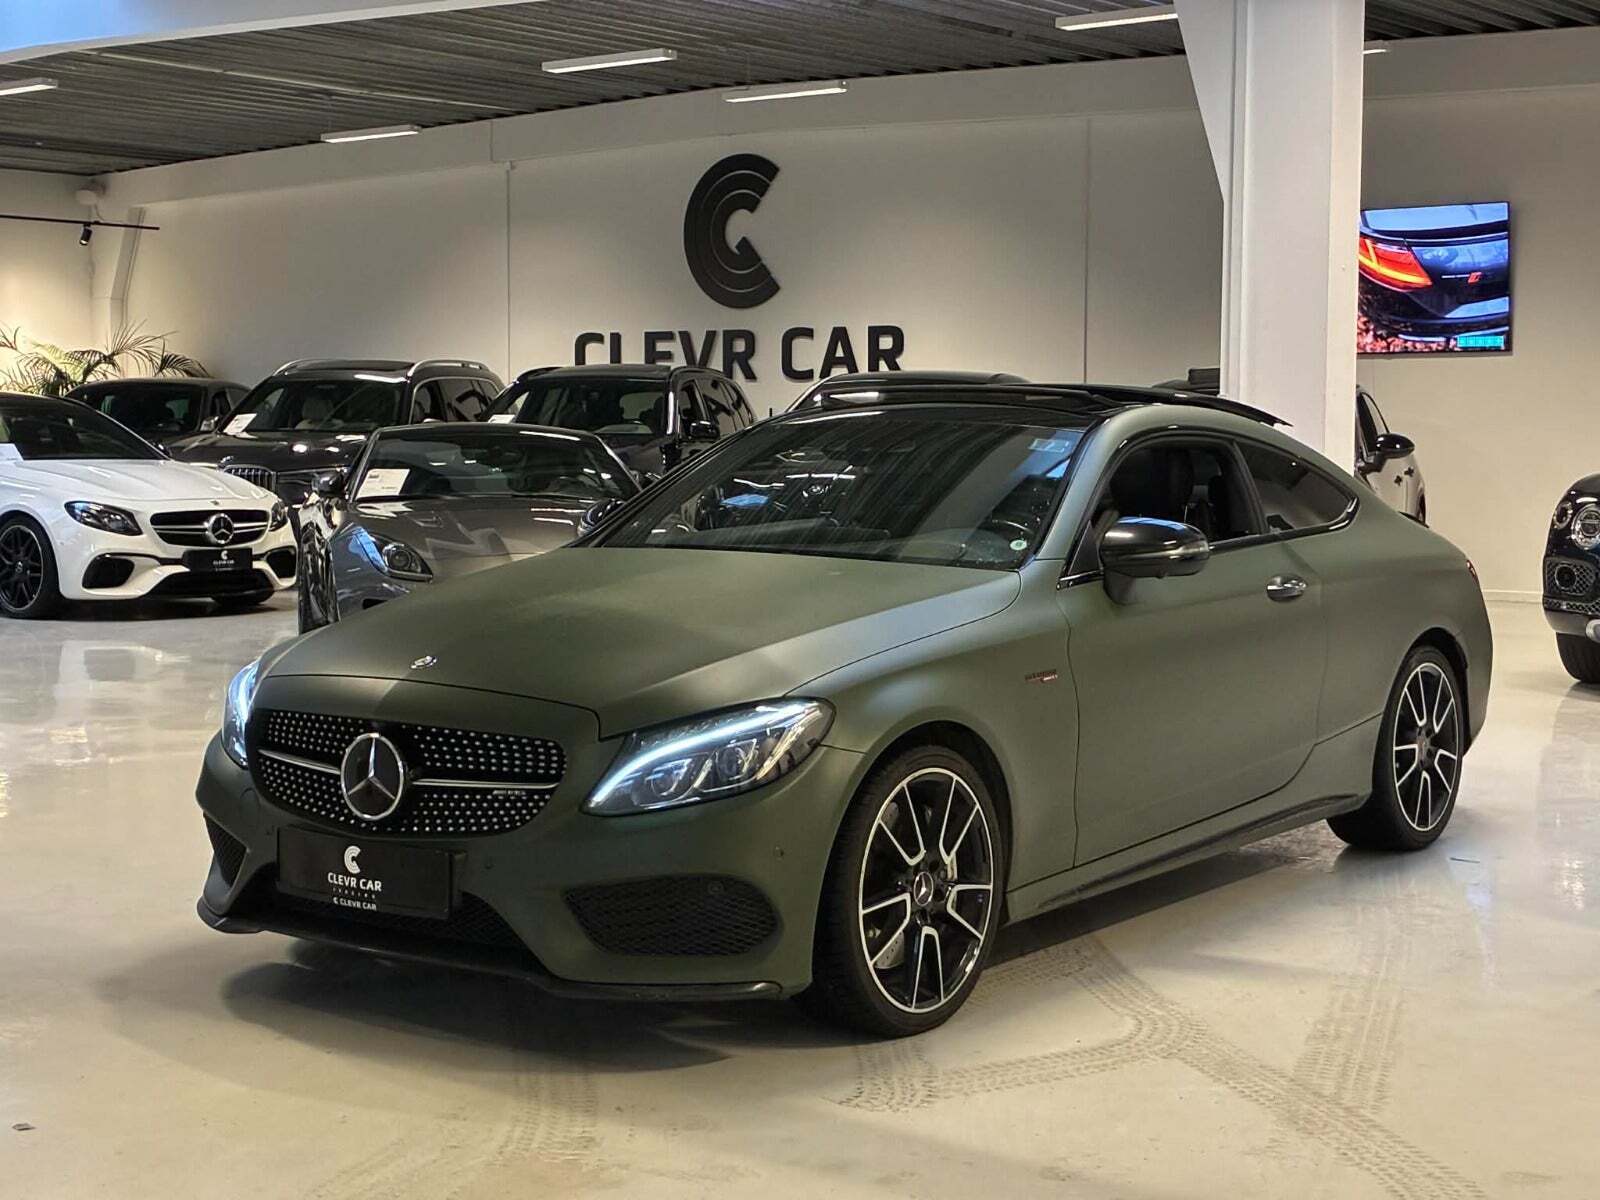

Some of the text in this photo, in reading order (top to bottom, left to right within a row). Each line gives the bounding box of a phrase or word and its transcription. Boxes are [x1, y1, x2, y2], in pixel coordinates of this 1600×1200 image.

[781, 325, 905, 380] CAR
[327, 872, 382, 892] CLEVR CAR
